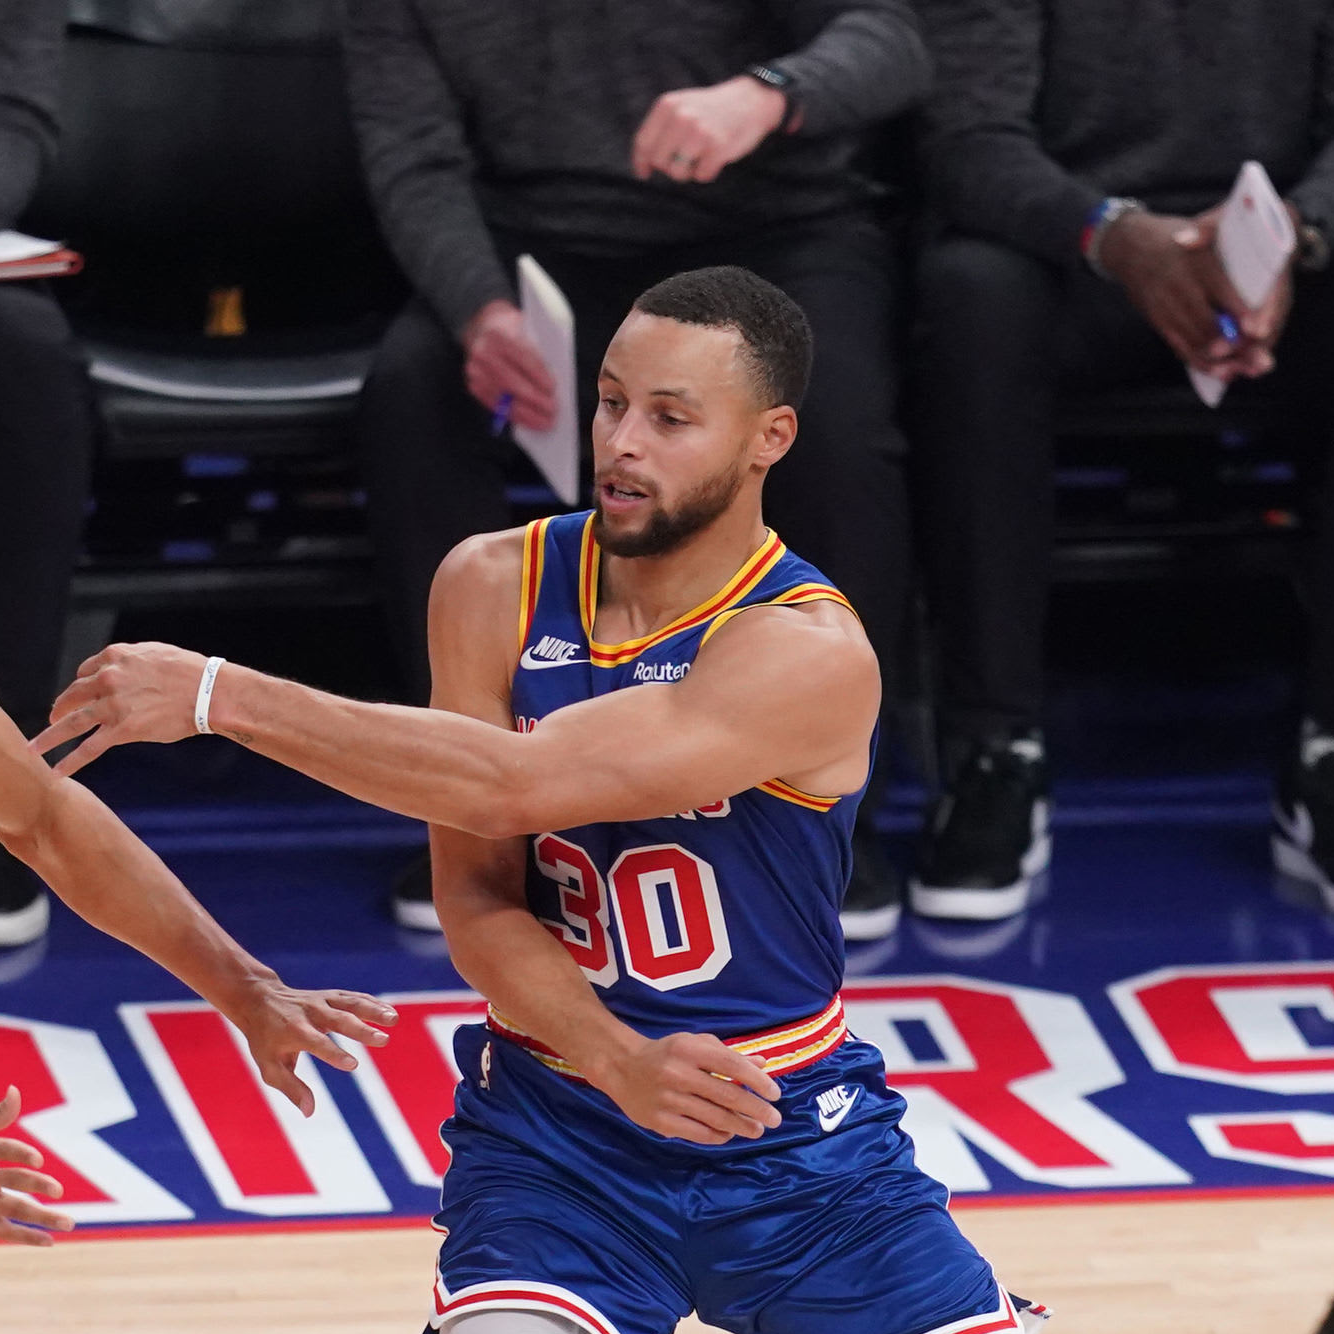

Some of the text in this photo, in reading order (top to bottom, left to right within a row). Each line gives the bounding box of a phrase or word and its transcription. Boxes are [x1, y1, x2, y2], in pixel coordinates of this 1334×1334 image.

[532, 635, 581, 662] NIKE
[533, 832, 733, 992] 30
[815, 1085, 848, 1116] NIKE
